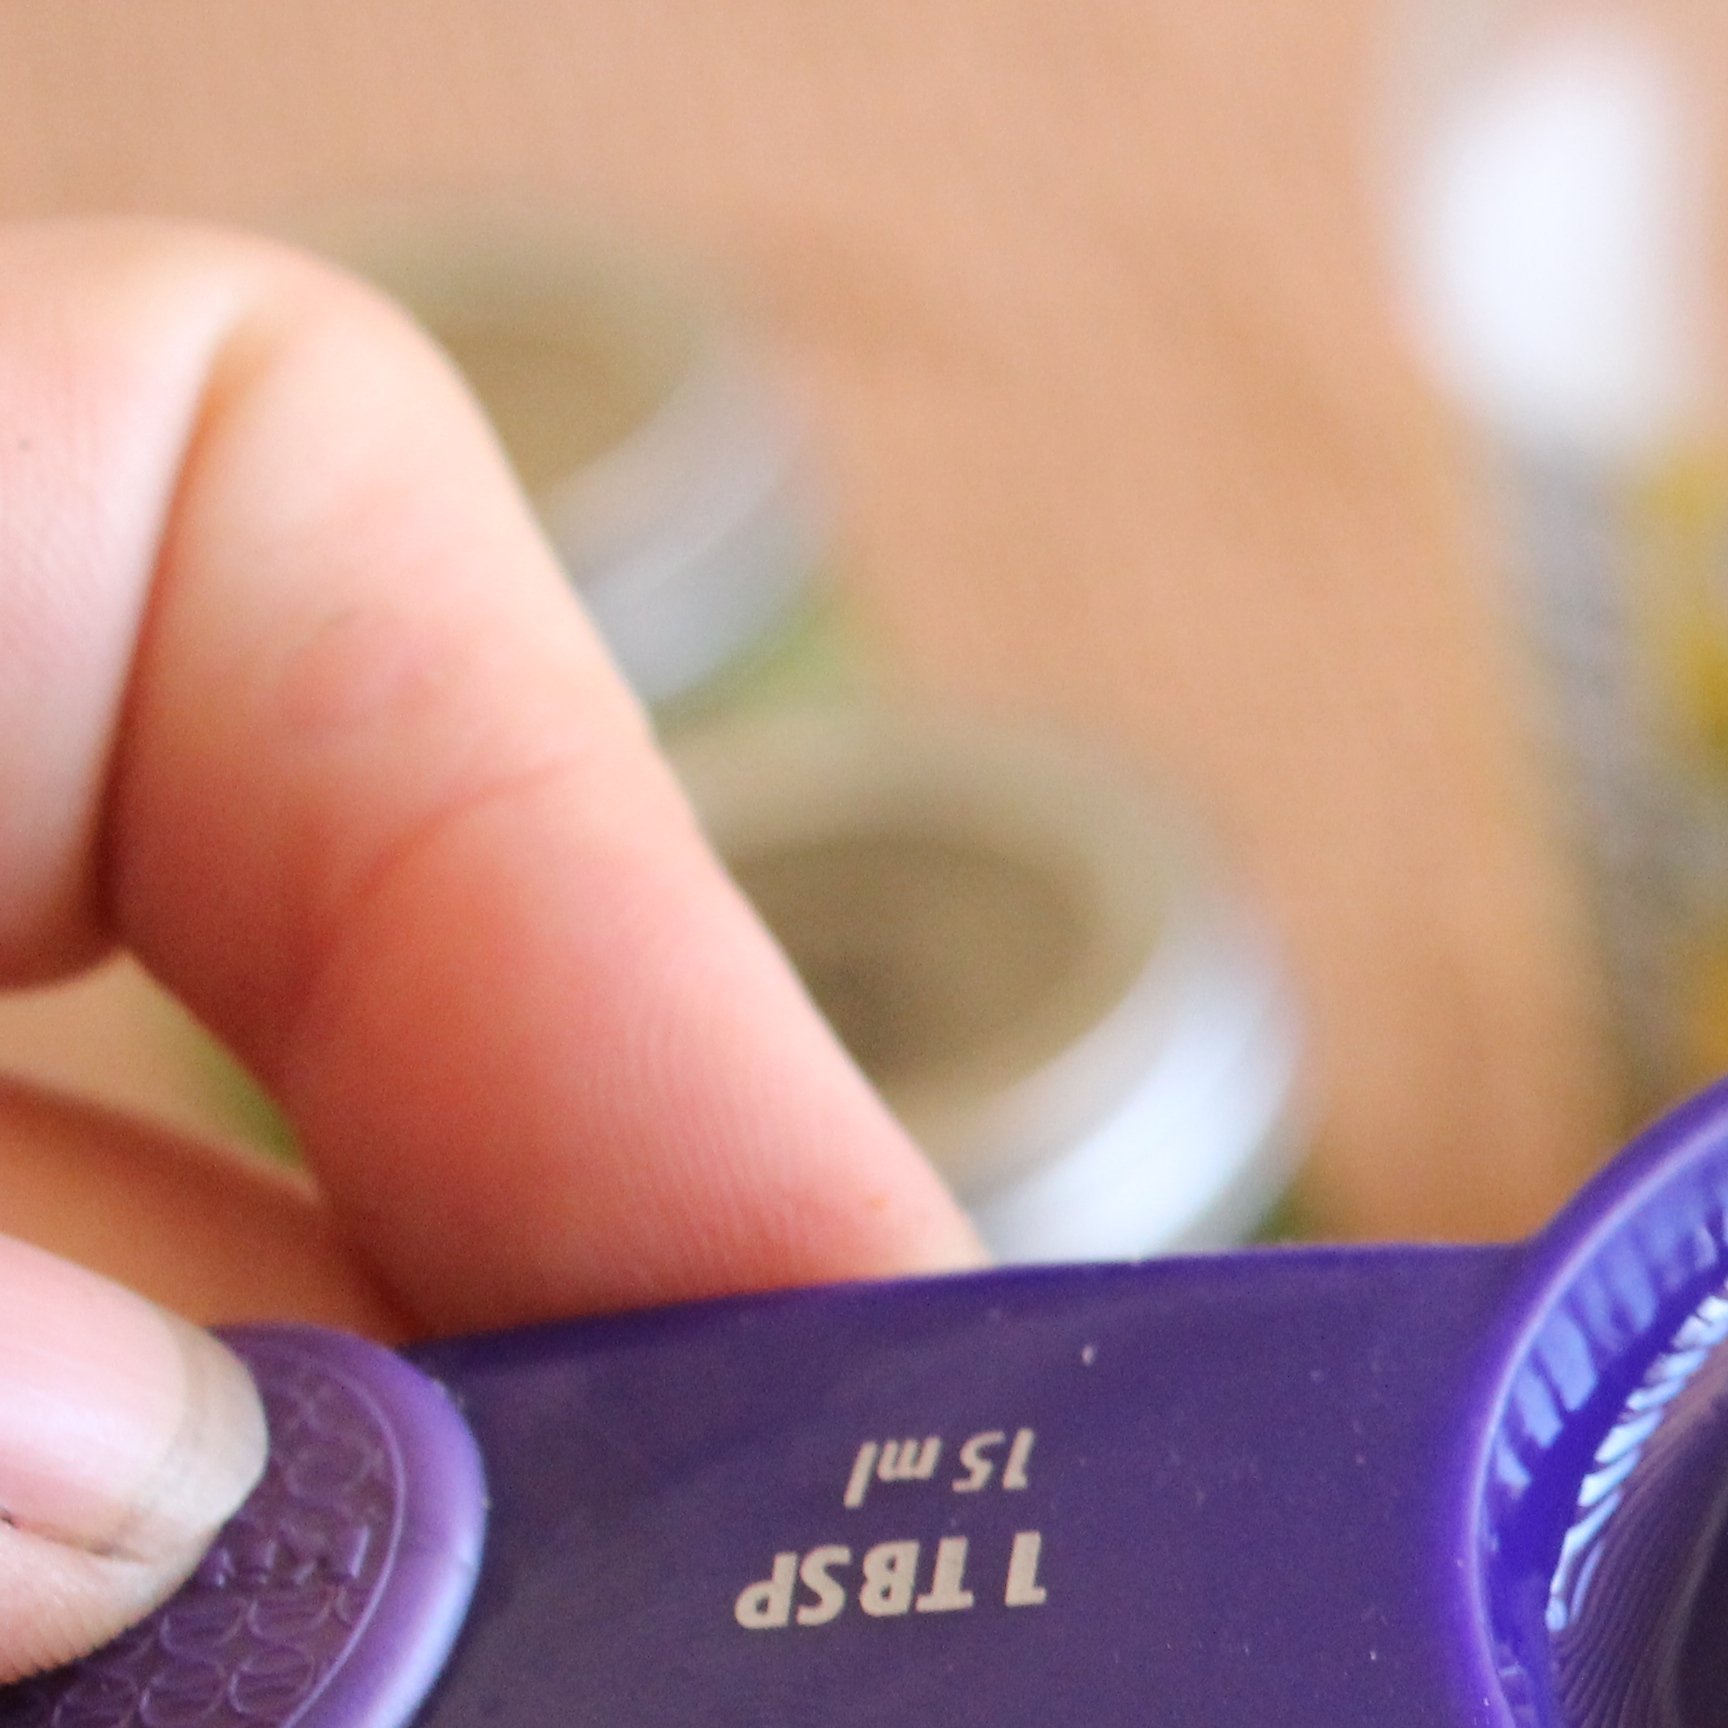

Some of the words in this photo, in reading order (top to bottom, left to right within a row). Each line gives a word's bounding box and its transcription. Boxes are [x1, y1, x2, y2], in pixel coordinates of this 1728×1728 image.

[845, 1437, 941, 1507] ml
[953, 1429, 1034, 1491] 15
[735, 1535, 974, 1629] TBSP
[1005, 1530, 1047, 1606] 1
